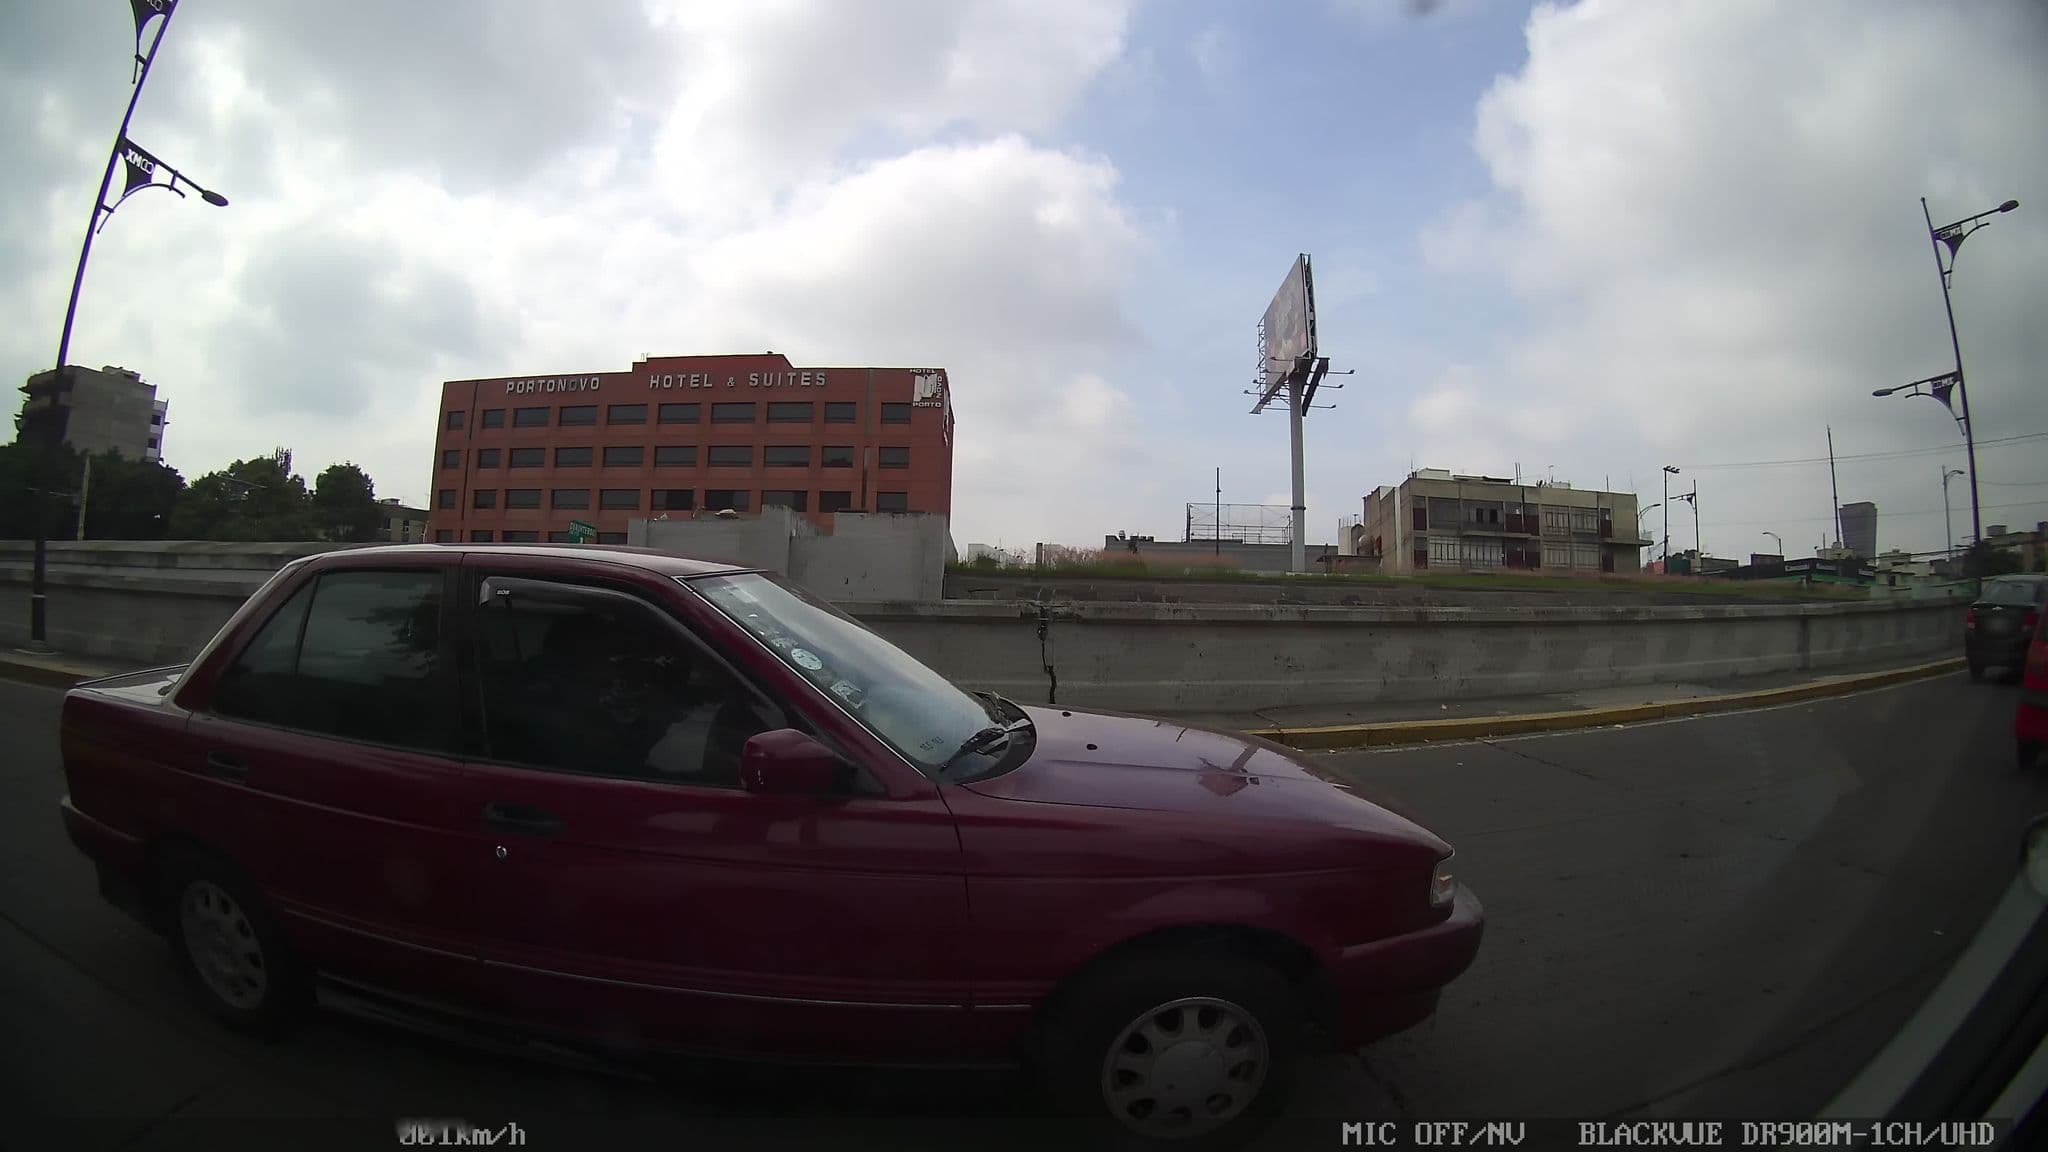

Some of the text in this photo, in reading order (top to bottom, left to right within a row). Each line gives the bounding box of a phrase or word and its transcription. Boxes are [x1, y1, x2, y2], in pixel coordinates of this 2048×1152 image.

[506, 372, 827, 394] PORTONOVO HOTEL & SUITES
